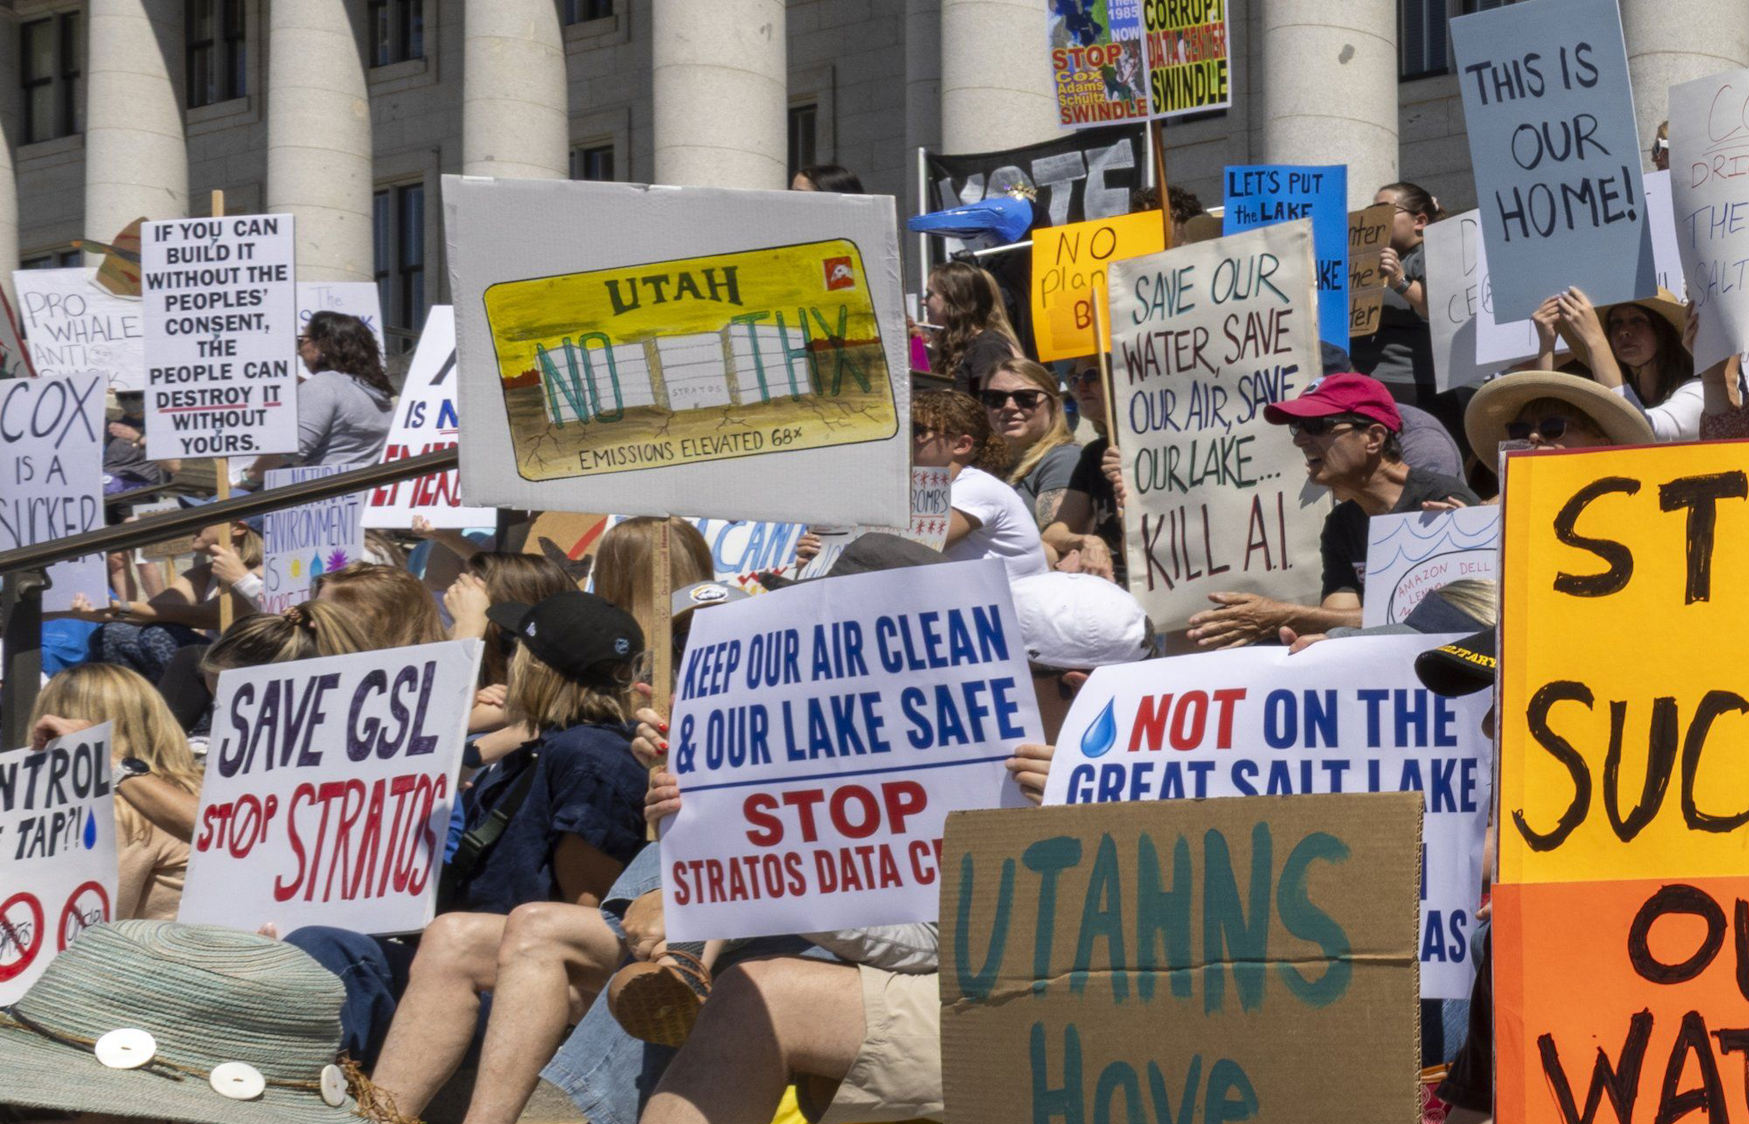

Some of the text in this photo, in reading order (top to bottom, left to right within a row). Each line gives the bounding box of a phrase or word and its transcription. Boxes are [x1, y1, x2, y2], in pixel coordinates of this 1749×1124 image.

[1111, 26, 1140, 42] NOW
[1147, 23, 1227, 70] DATA CENTER
[1052, 43, 1123, 70] STOP
[1464, 41, 1599, 106] THIS IS
[1055, 71, 1102, 83] Cox
[1057, 81, 1105, 94] Adams
[1151, 60, 1228, 114] SWINDLE
[1059, 92, 1105, 106] Schultz
[1060, 99, 1148, 125] SWINDLE
[1511, 113, 1611, 170] OUR
[1289, 173, 1323, 195] PUT
[1495, 165, 1637, 242] HOME!
[154, 218, 279, 242] IF YOU CAN
[1234, 202, 1313, 224] the LAKE
[1683, 202, 1749, 249] THE
[166, 243, 255, 265] BUILD IT
[1056, 227, 1117, 265] NO
[146, 265, 288, 290] WITHOUT THE
[604, 265, 744, 317] UTAH
[1041, 268, 1105, 308] plan
[1132, 265, 1196, 326] SAVE
[1212, 252, 1290, 305] OUR
[25, 291, 86, 328] PRO
[44, 315, 144, 344] WHALE
[165, 313, 270, 336] CONSENT,
[1074, 300, 1092, 330] B
[197, 339, 237, 358] THE
[1122, 326, 1221, 385] WATER,
[1224, 307, 1293, 365] SAVE
[150, 364, 232, 385] PEOPLE
[243, 360, 288, 379] CAN
[536, 305, 872, 429] NO THX
[156, 385, 281, 409] DESTROY IT
[672, 385, 722, 397] STRATOS
[1129, 363, 1300, 435] OUR AIR, SAVE
[0, 376, 100, 450] COX
[172, 409, 267, 431] WITHOUT
[404, 400, 426, 429] IS
[180, 434, 260, 456] YOURS.
[579, 439, 674, 471] EMISSIONS
[681, 430, 763, 458] ELEVATED
[16, 454, 67, 486] IS A
[1134, 444, 1189, 494] OUR
[265, 502, 358, 554] ENVIRONMENT
[1141, 503, 1231, 591] KILL
[1398, 561, 1449, 599] AMAZON
[1459, 562, 1491, 575] DELL
[682, 604, 1010, 701] KEEP OUR AIR CLEAN
[218, 660, 439, 779] SAVE GSL
[676, 677, 1025, 774] & OUR LAKE SAFE
[1128, 687, 1457, 752] NOT ON THE
[1366, 757, 1478, 814] LAKE
[14, 806, 82, 860] TAP?!
[743, 780, 927, 847] STOP
[196, 773, 448, 903] STOP STRATOS
[672, 851, 807, 906] STRATOS
[814, 843, 904, 894] DATA
[953, 821, 1352, 1017] UTAHNS
